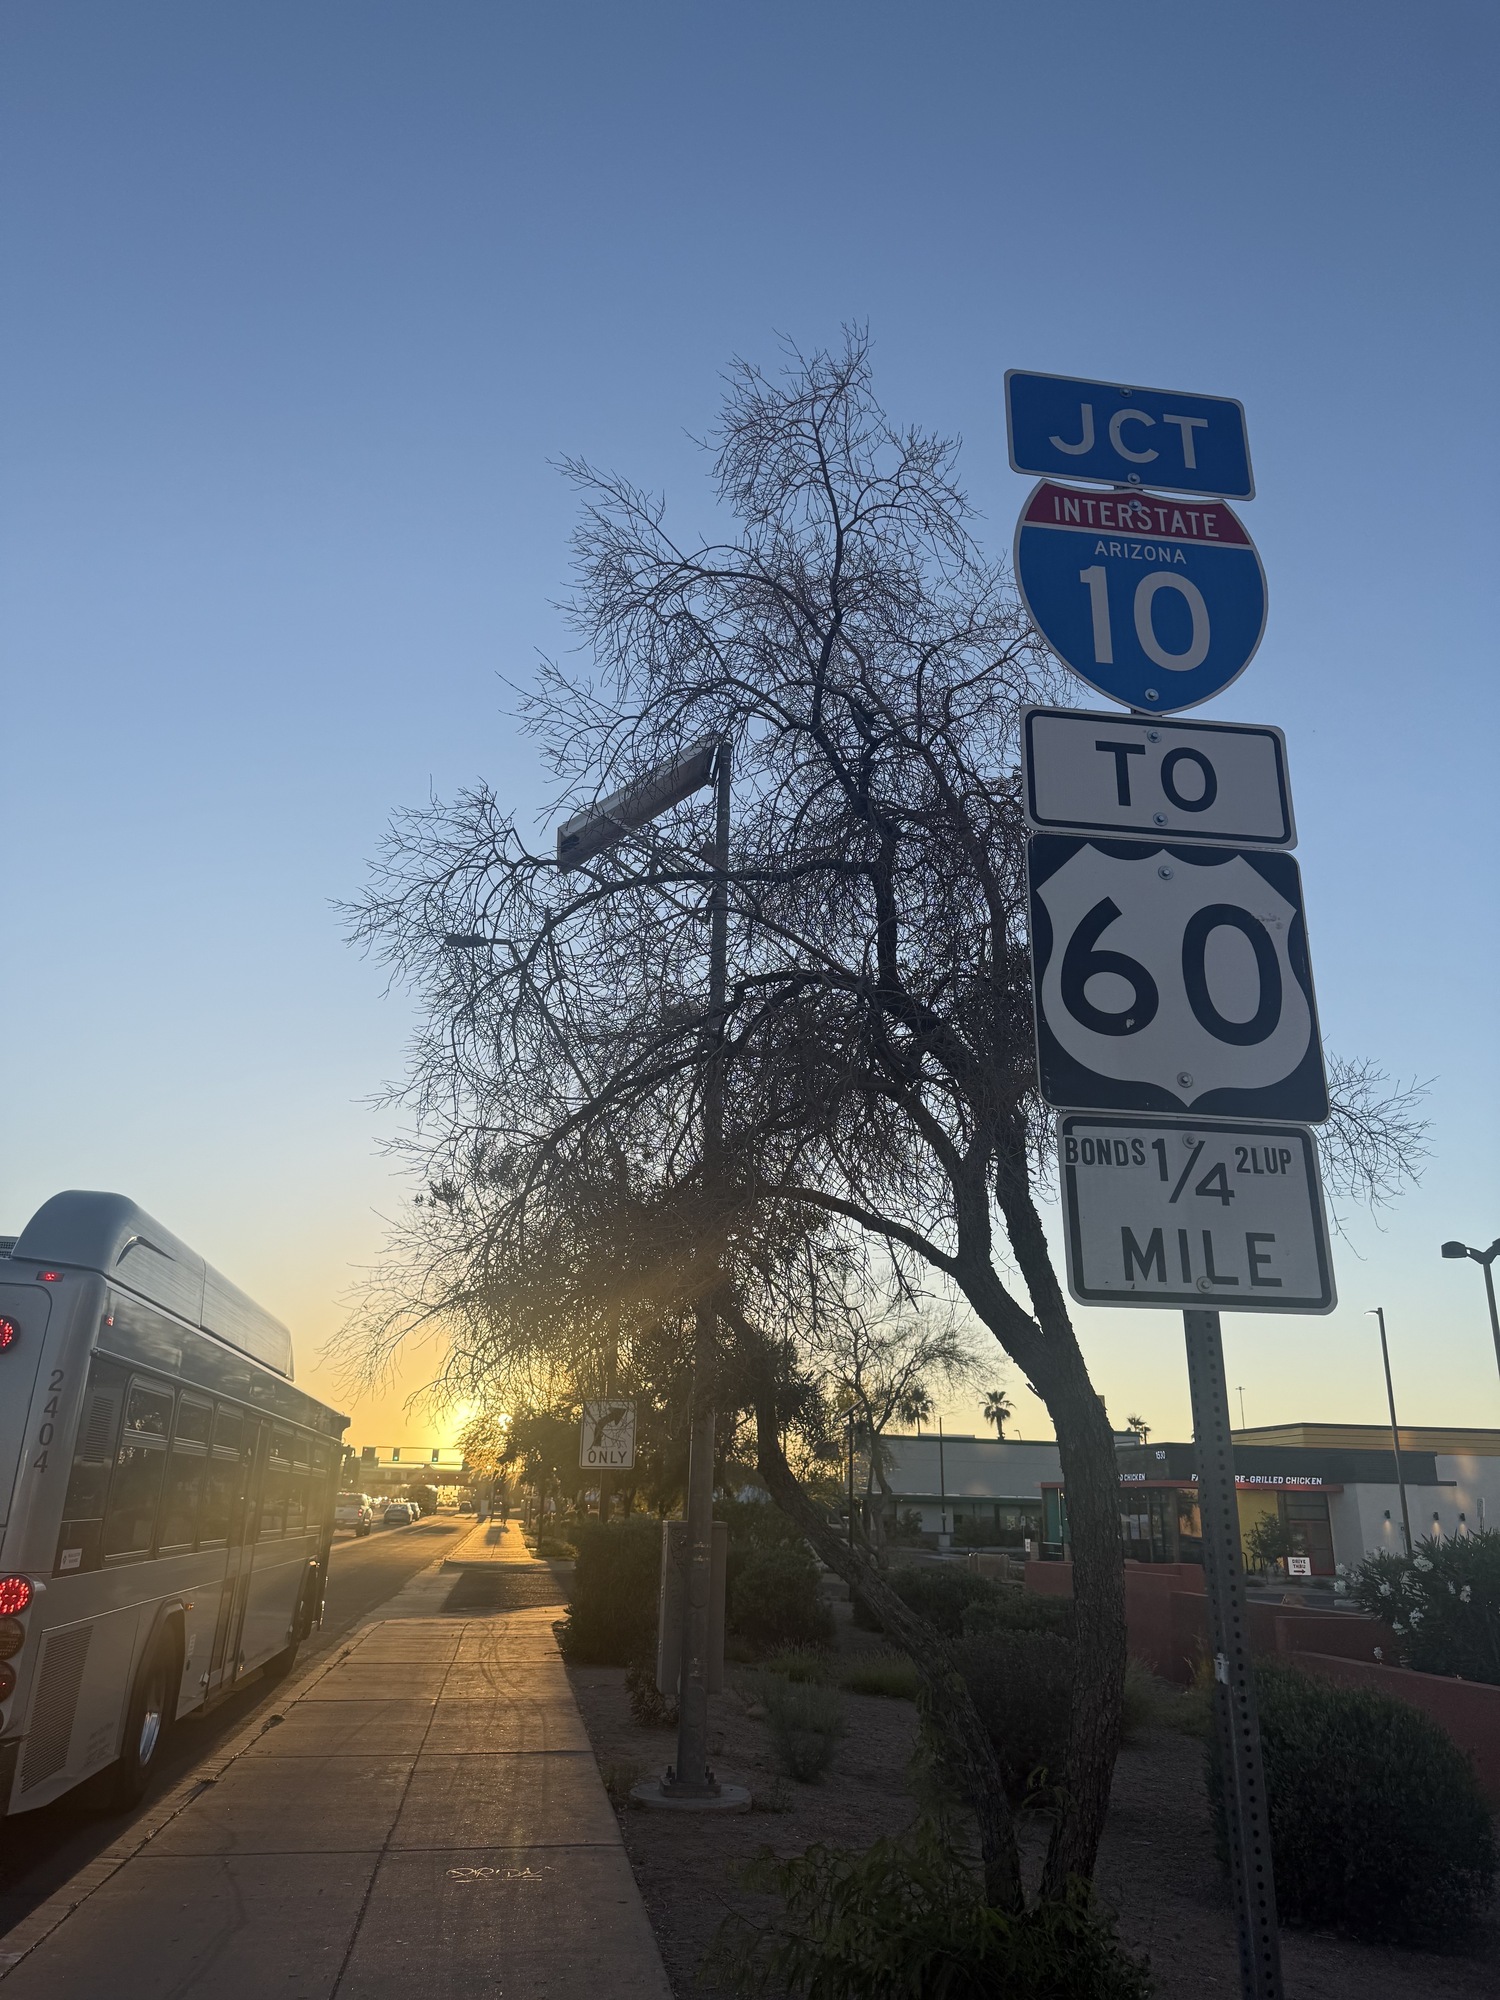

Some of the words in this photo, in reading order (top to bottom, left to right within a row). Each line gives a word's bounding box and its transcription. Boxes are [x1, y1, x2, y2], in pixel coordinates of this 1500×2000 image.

[1048, 402, 1209, 470] JCT
[1053, 495, 1220, 538] INTERSTATE
[1094, 539, 1187, 565] ARIZONA
[1079, 564, 1211, 672] 10
[1094, 740, 1218, 813] TO
[1060, 895, 1283, 1047] 60
[1064, 1136, 1146, 1167] BONDS
[1151, 1138, 1236, 1207] 1/4
[1234, 1146, 1292, 1175] 2LUP
[1120, 1226, 1283, 1288] MILE
[32, 1368, 65, 1474] 2404
[587, 1449, 628, 1464] ONLY
[1123, 1473, 1146, 1482] CHICKEN
[1234, 1474, 1284, 1484] RE-GRILLED
[1285, 1476, 1323, 1485] CHICKEN
